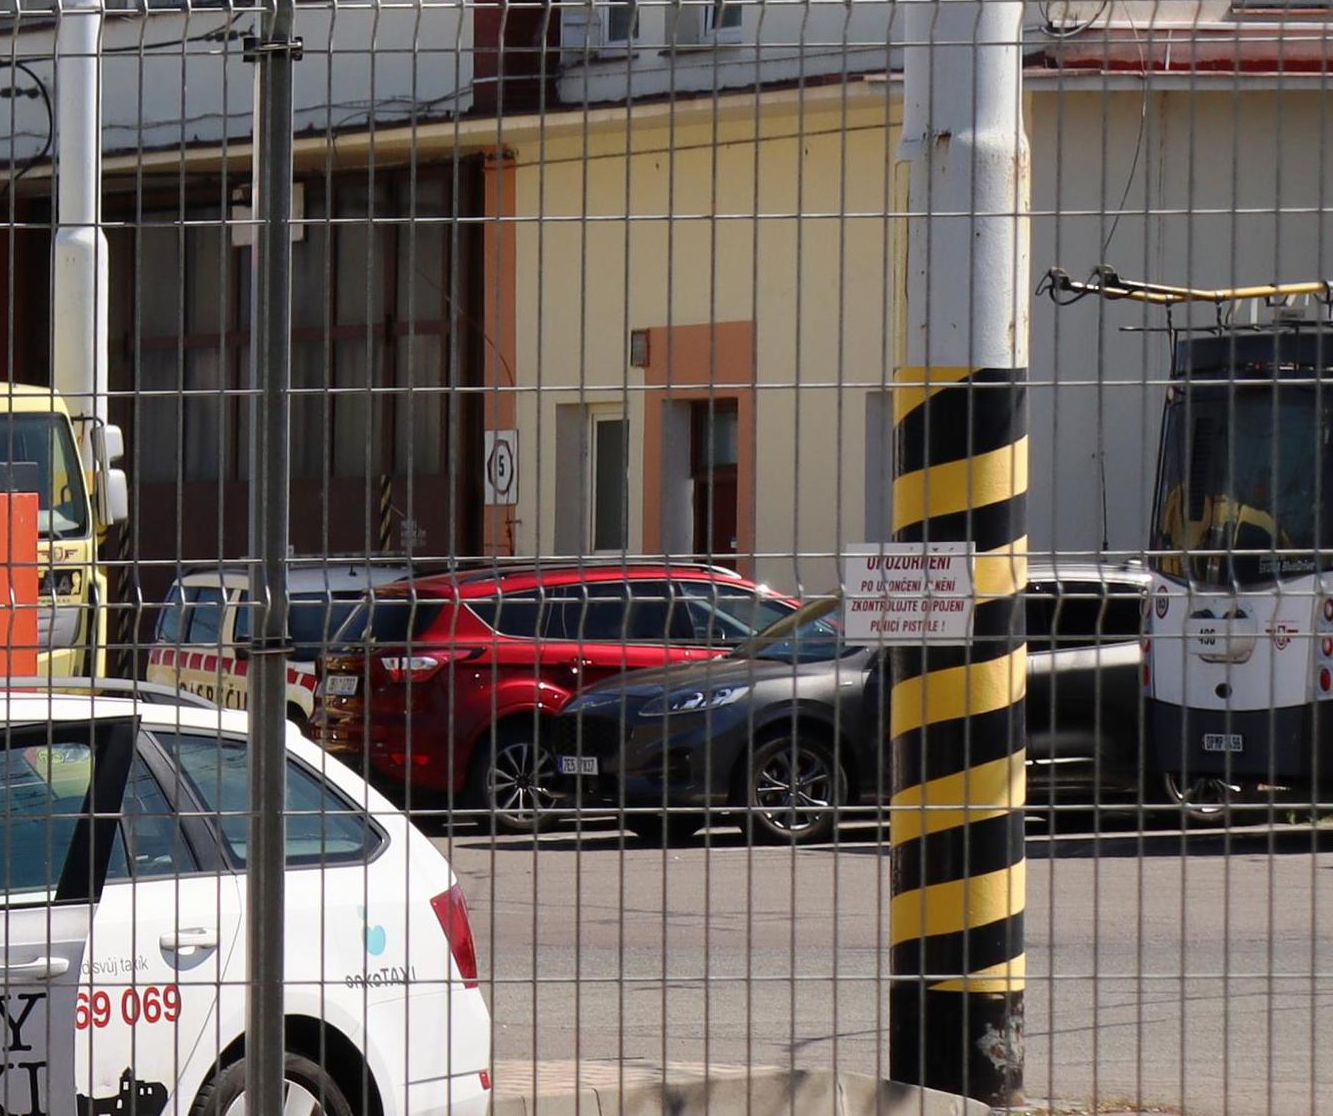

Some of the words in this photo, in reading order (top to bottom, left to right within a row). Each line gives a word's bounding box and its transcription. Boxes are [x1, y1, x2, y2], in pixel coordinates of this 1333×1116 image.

[499, 455, 504, 477] 5
[867, 547, 952, 570] UOZORĚNÍ
[861, 580, 873, 592] PO
[876, 577, 922, 592] UONČENÍ
[924, 577, 956, 592] PNĚNÍ
[903, 620, 938, 632] PISTLE
[121, 983, 182, 1026] 069
